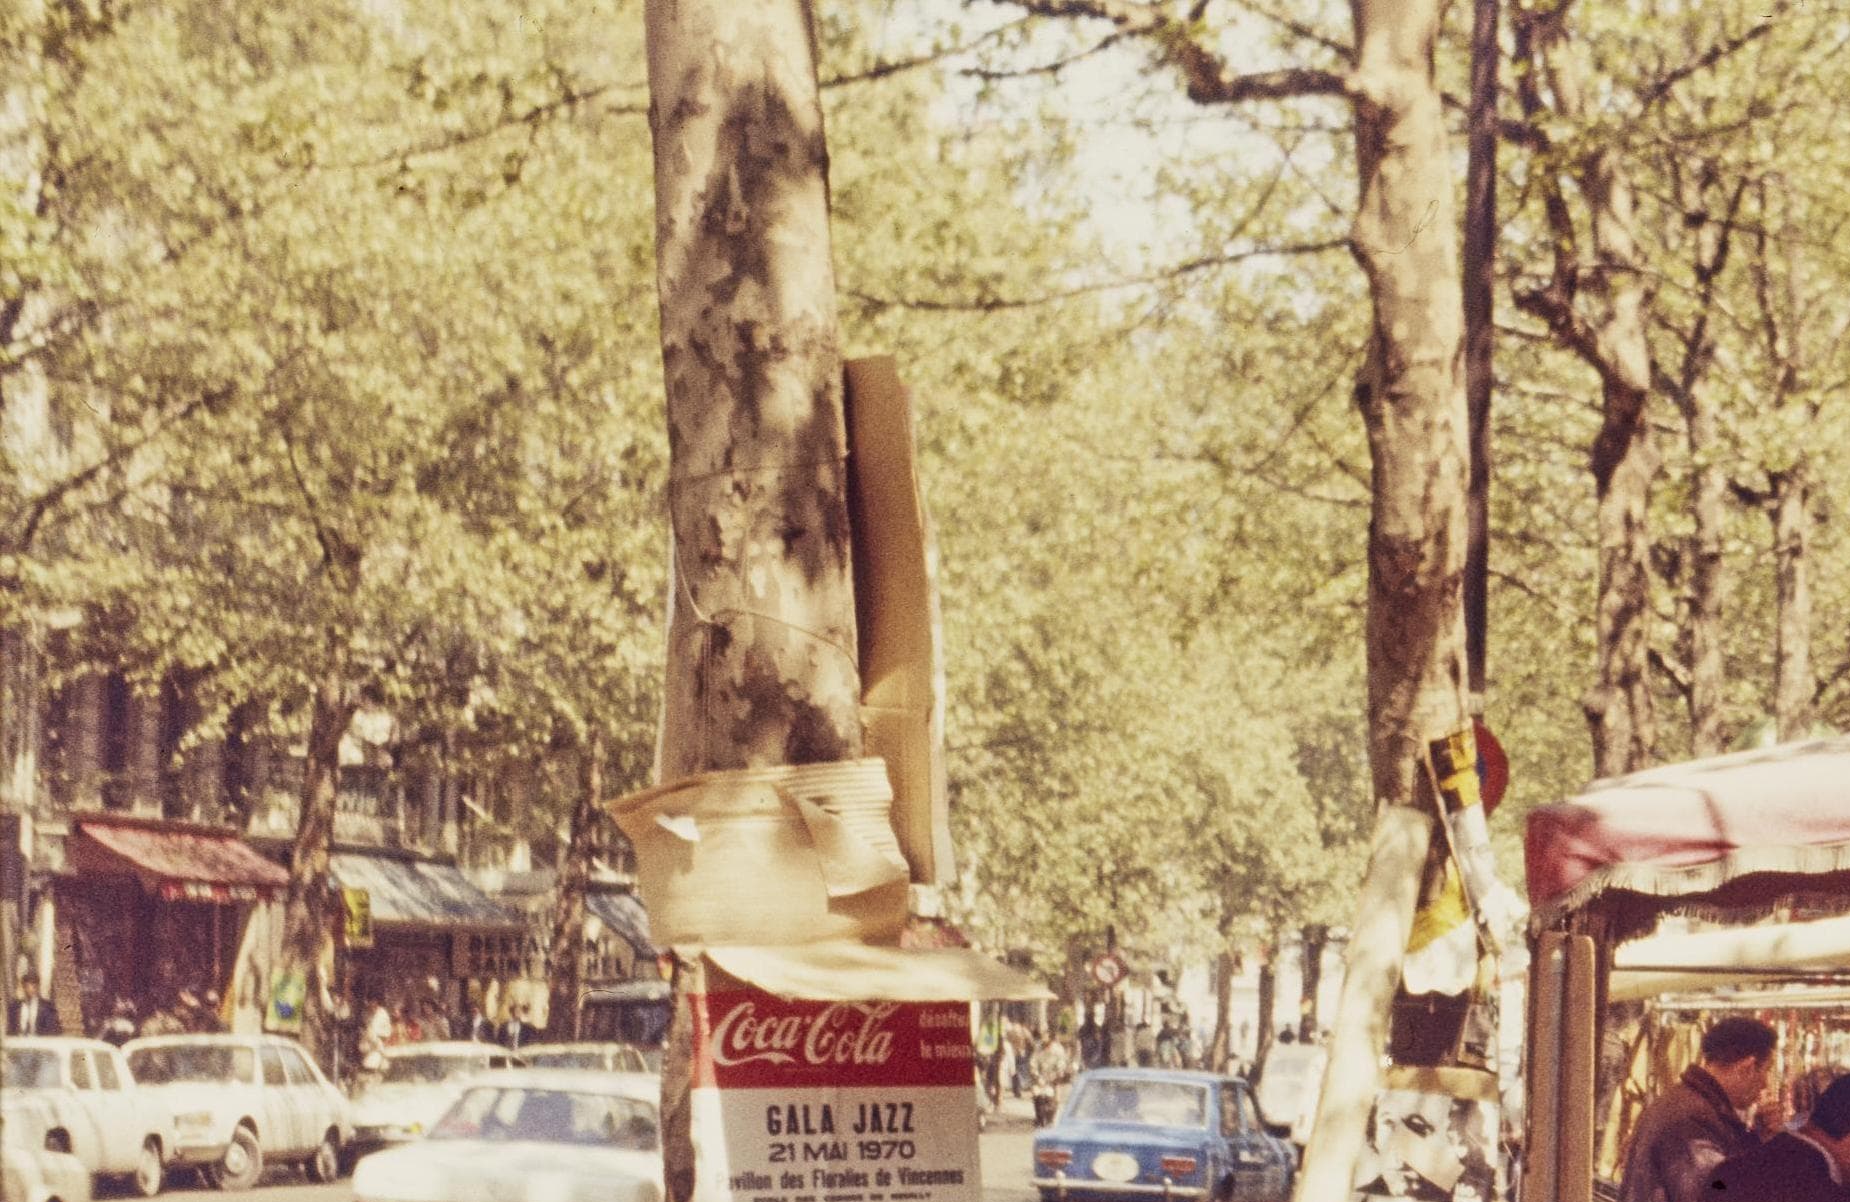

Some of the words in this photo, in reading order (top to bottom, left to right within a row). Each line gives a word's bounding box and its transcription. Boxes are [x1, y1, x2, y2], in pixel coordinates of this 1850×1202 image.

[710, 1001, 903, 1066] Coca-Cola
[767, 1104, 835, 1135] GALA
[853, 1102, 915, 1134] JAZZ
[769, 1144, 795, 1163] 21
[803, 1142, 848, 1162] MAI
[858, 1140, 916, 1160] 1970
[780, 1168, 804, 1190] des
[812, 1167, 868, 1189] Floralies
[876, 1167, 891, 1187] de
[899, 1166, 964, 1186] Vincennes
